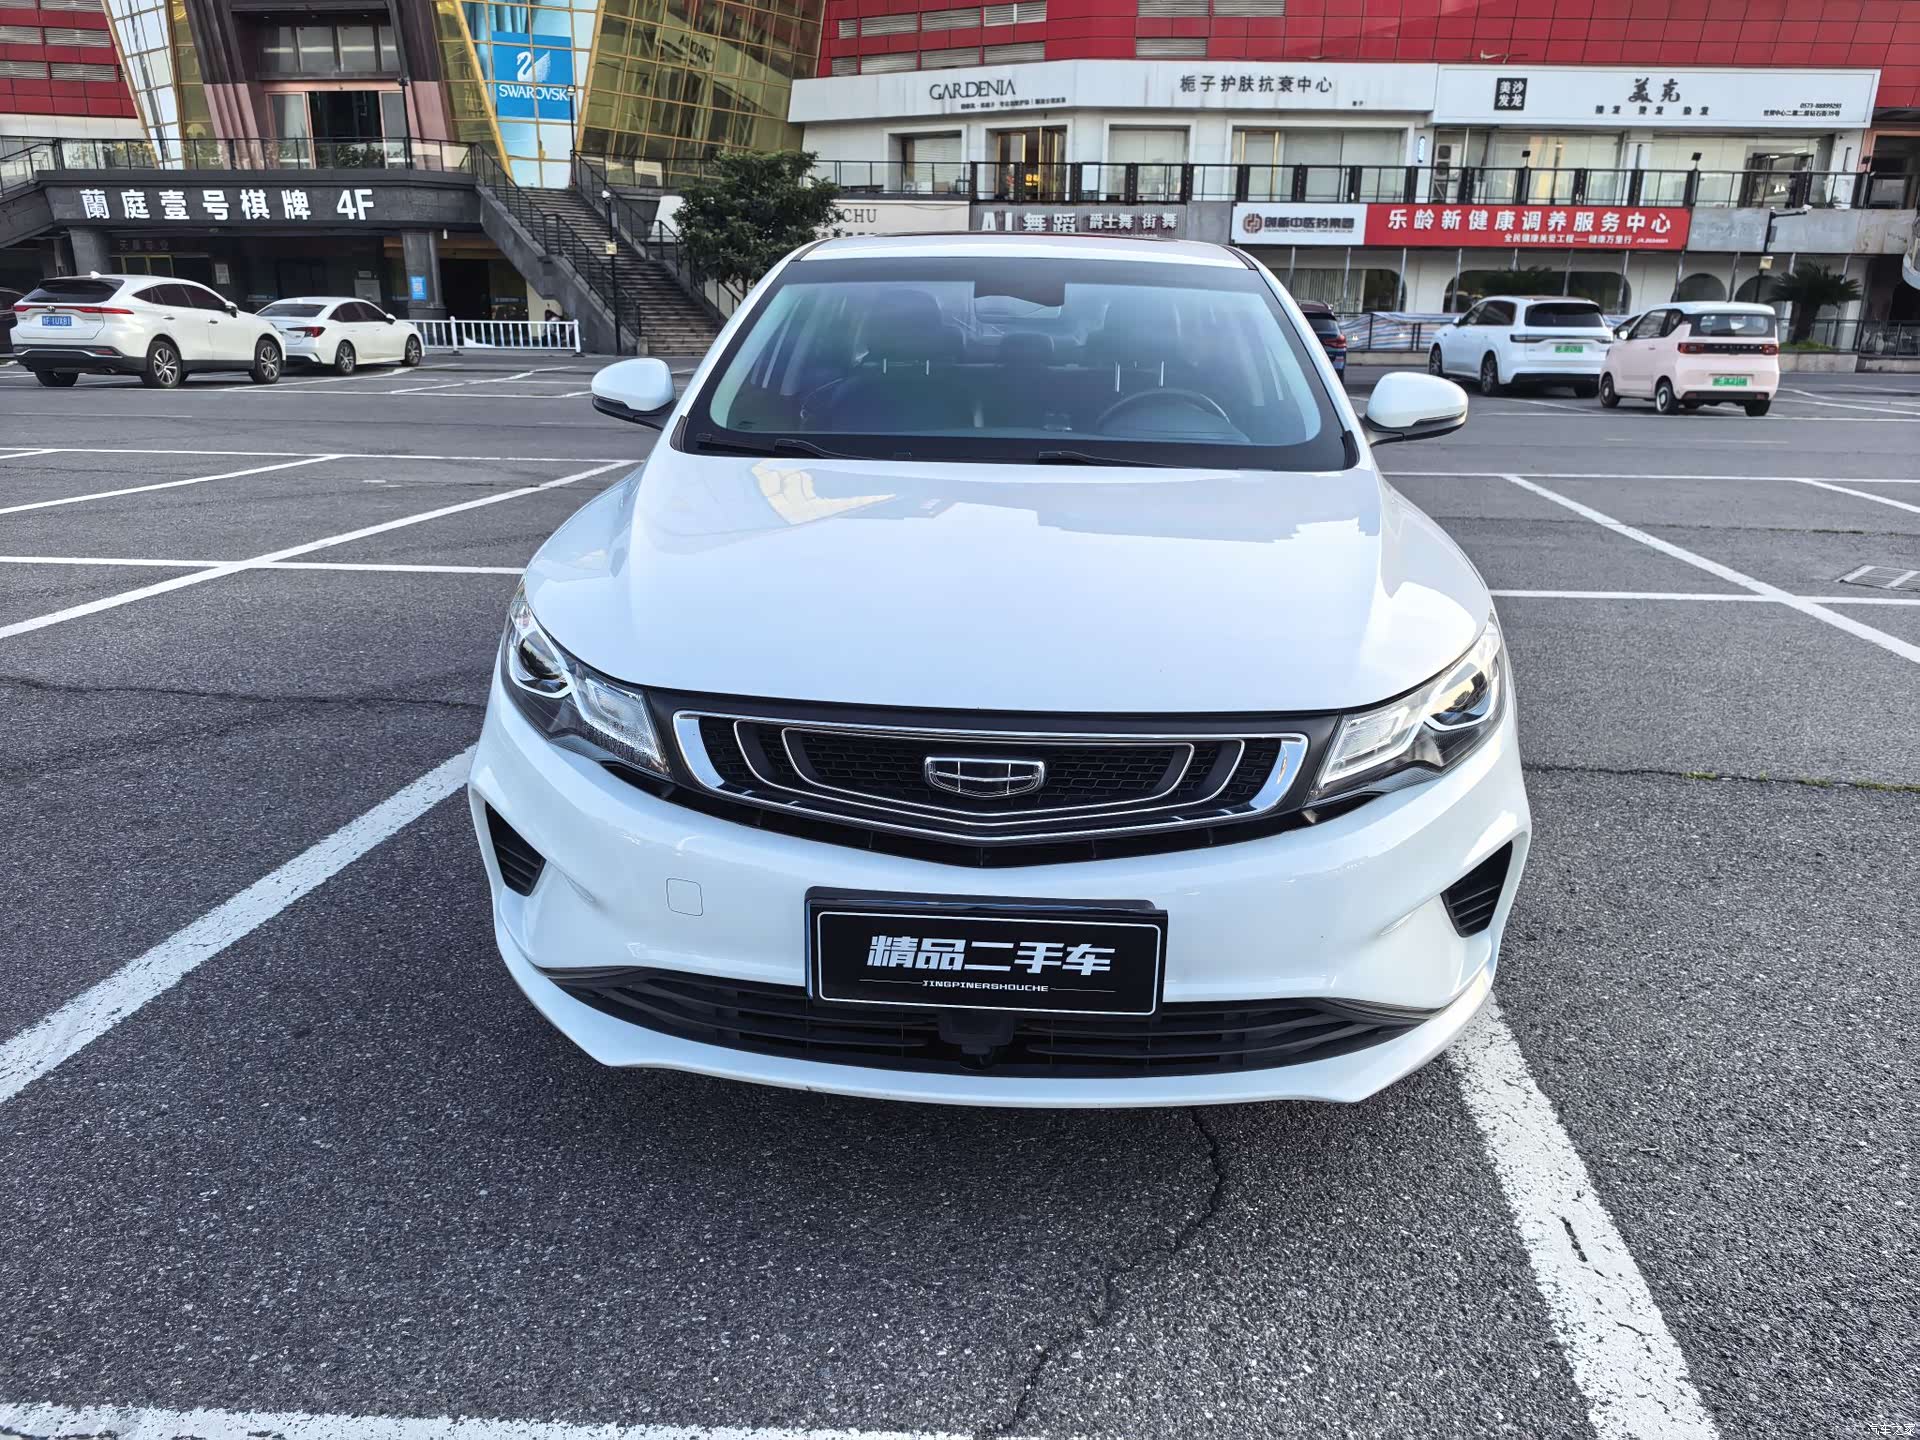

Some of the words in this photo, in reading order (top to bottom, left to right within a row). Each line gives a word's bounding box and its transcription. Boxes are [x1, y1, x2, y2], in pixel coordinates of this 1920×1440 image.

[498, 84, 570, 101] SWAROVSK
[929, 79, 1016, 100] GARDENIA
[1179, 75, 1333, 93] 栀子护肤抗衰中心
[80, 188, 311, 220] 蘭庭壹号棋牌
[336, 188, 375, 220] 4F
[841, 208, 878, 223] CHU
[1089, 213, 1133, 229] 爵士舞
[1142, 212, 1177, 229] 街舞
[1387, 208, 1671, 234] 乐龄新健康调养服务中心
[866, 935, 1116, 976] 精品二手车
[922, 979, 1049, 993] JINGPINERSHOUCHE
